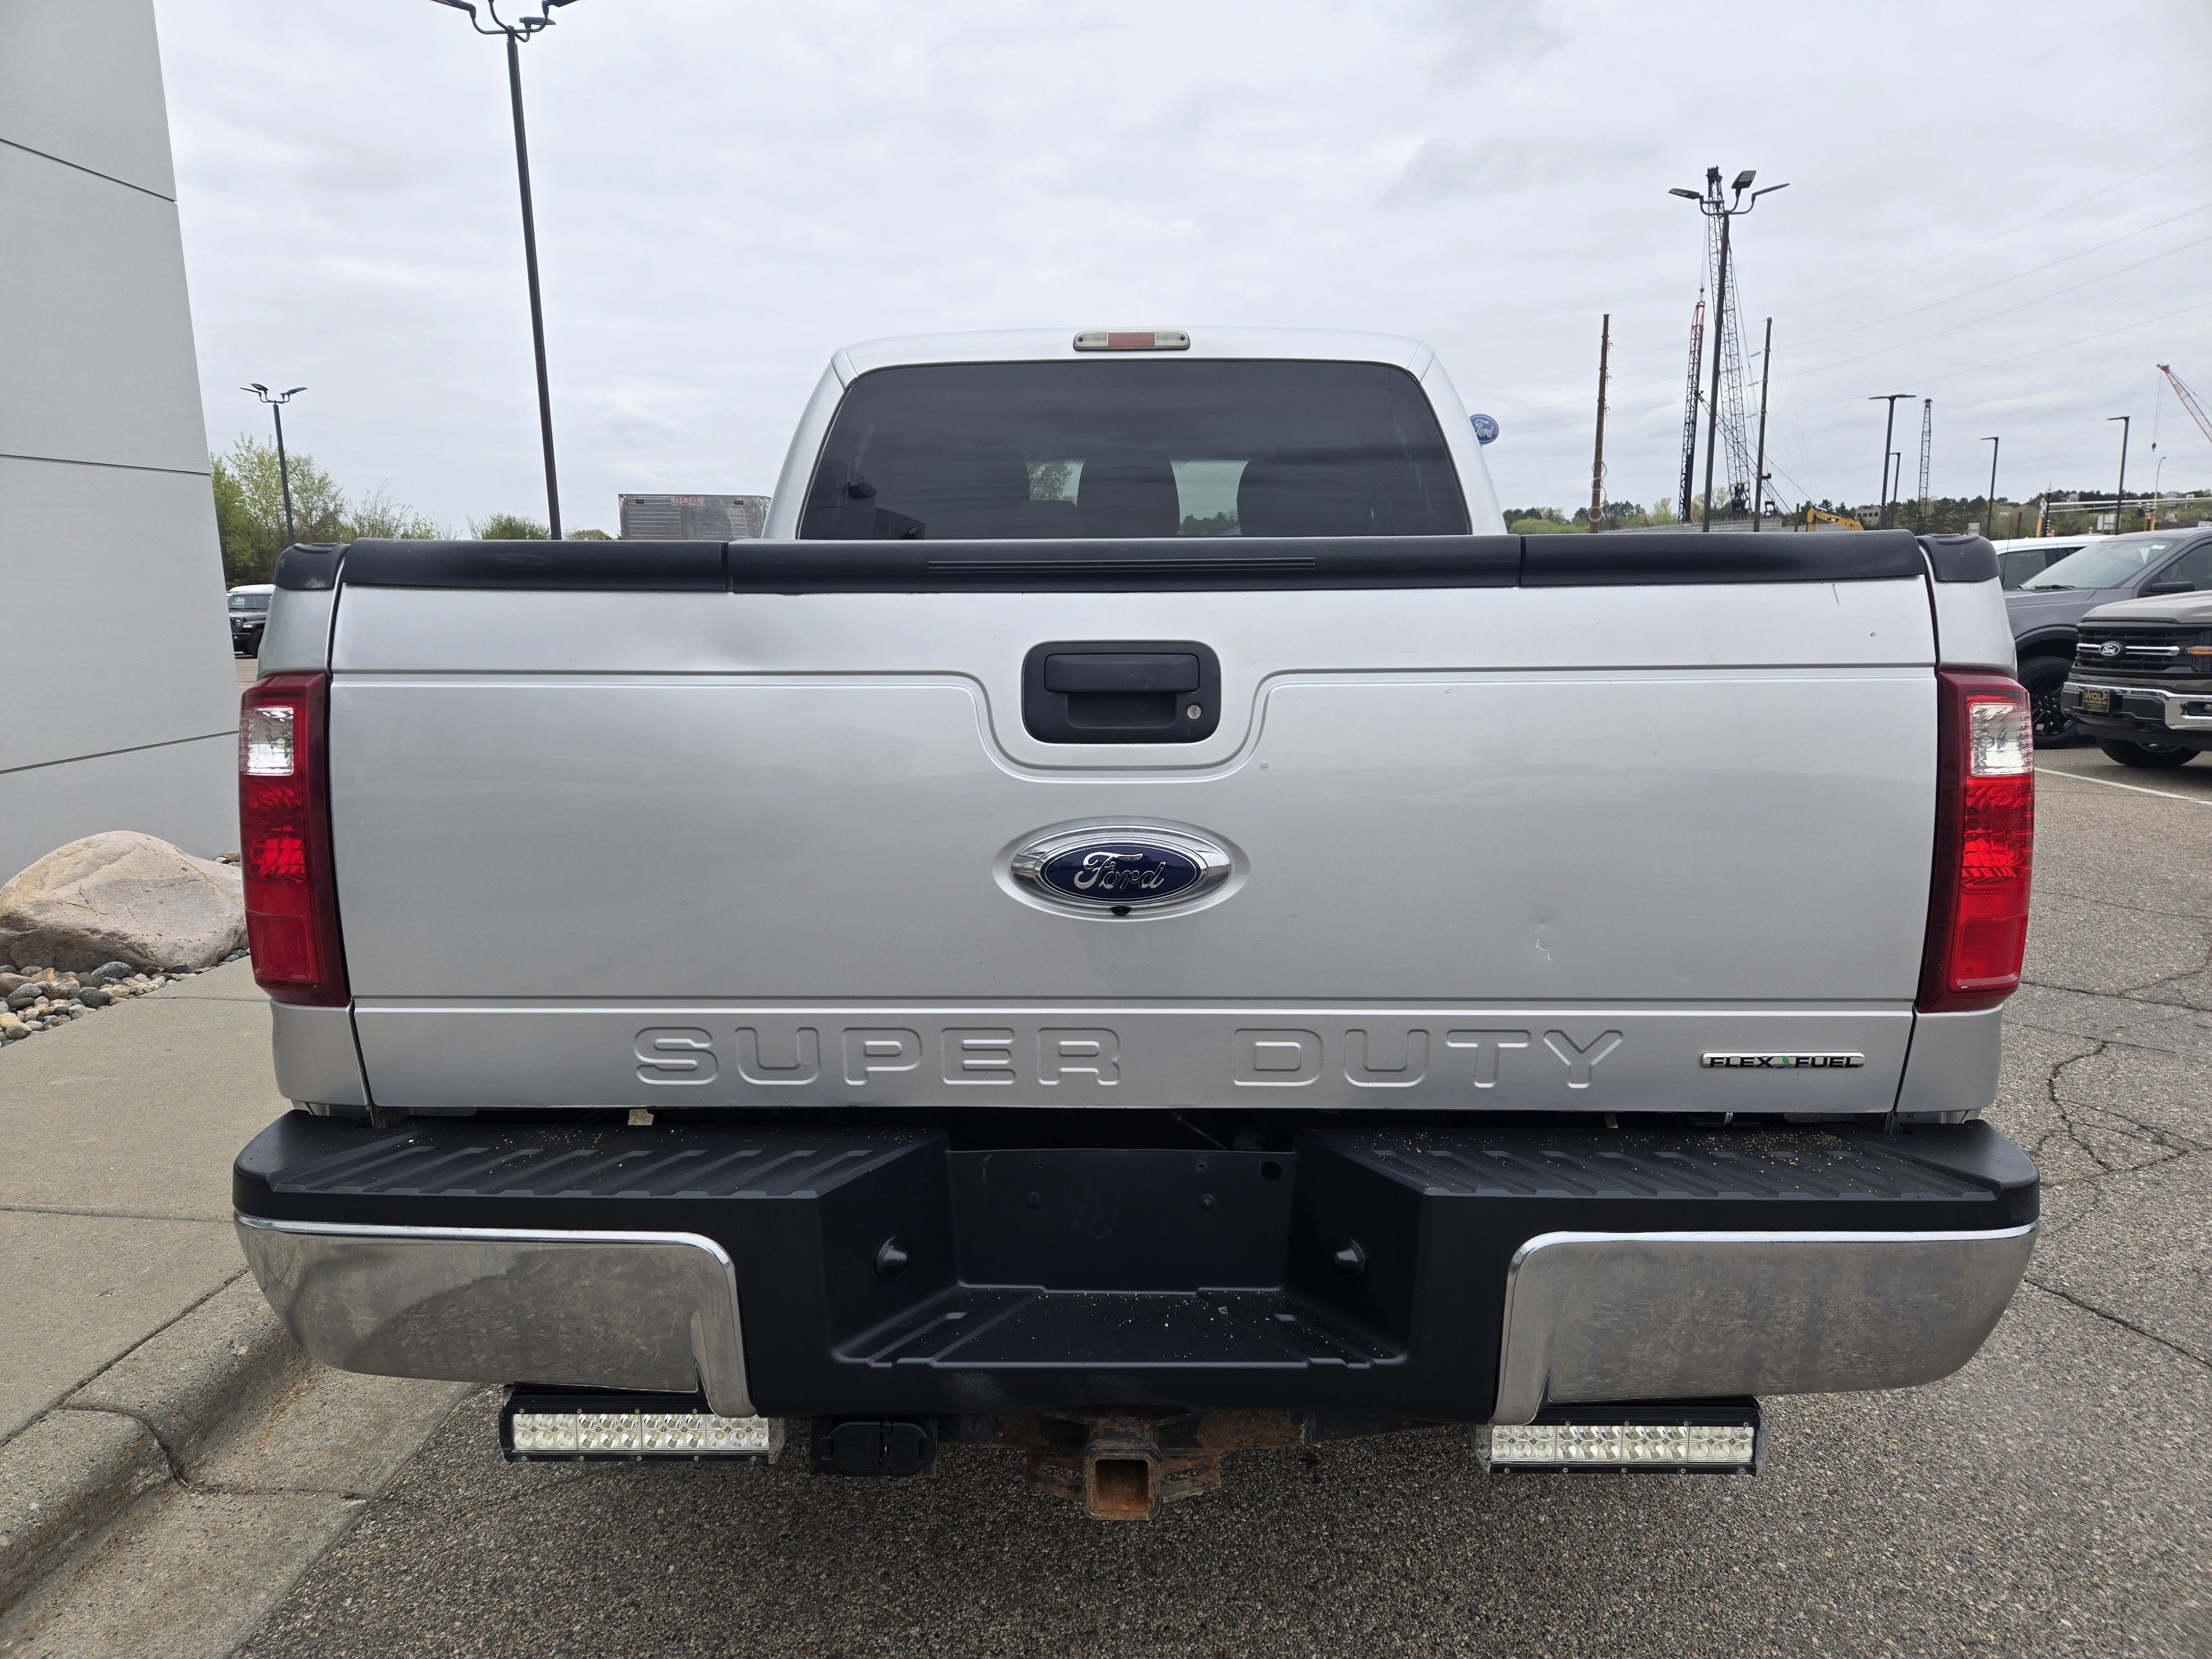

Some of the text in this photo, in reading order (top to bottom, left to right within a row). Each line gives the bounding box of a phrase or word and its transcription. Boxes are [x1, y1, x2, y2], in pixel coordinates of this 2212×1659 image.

[1474, 419, 1493, 437] Ford
[2103, 644, 2116, 653] Ford
[2084, 691, 2108, 701] WOLF
[1074, 852, 1165, 889] Ford
[633, 1026, 1624, 1088] SUPER DUTY
[1709, 1056, 1859, 1068] FLEX FUEL
